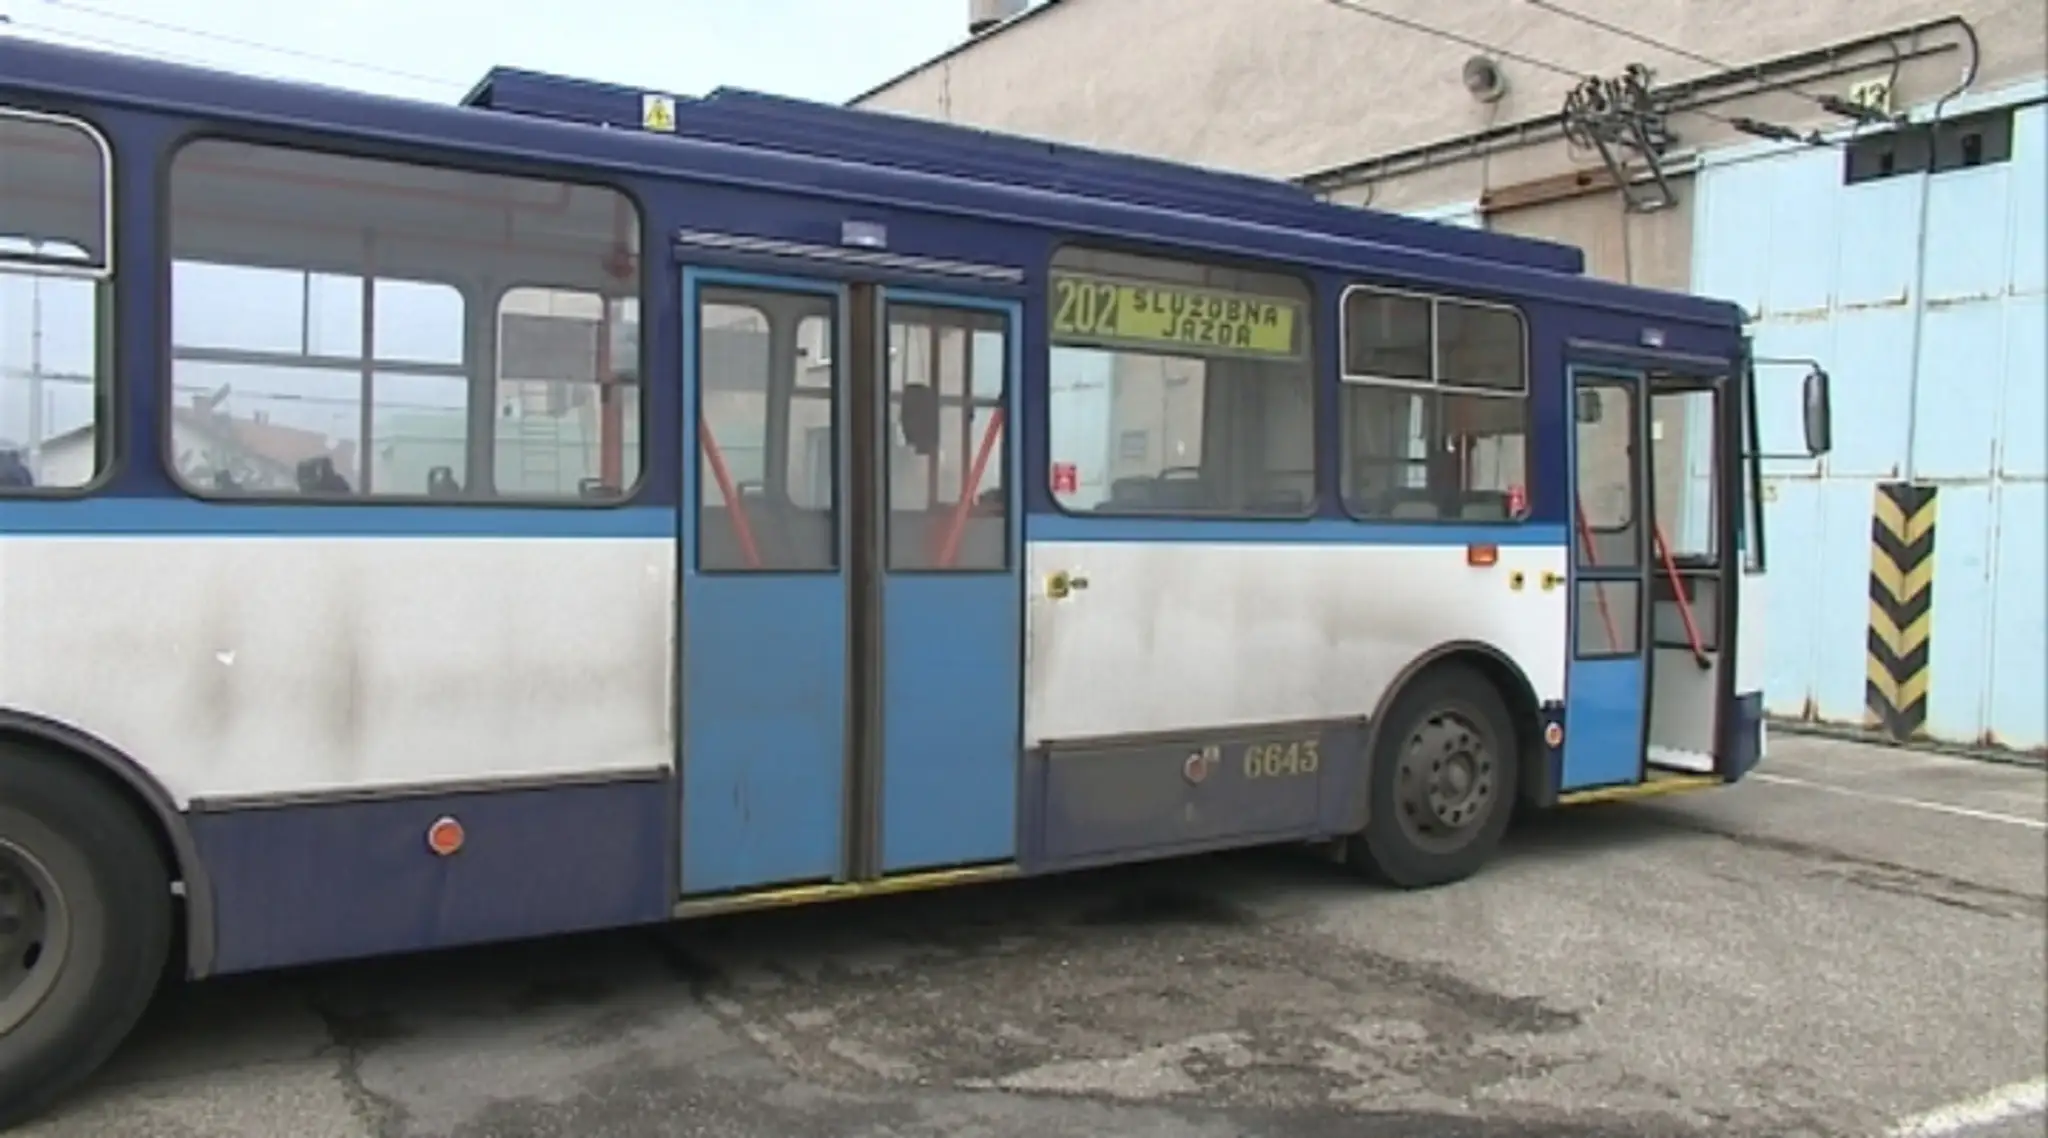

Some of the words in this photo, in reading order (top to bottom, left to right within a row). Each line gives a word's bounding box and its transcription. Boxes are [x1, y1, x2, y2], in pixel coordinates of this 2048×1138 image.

[1054, 278, 1117, 335] 202
[1161, 315, 1251, 346] JAZDA
[1243, 740, 1318, 779] 6643
